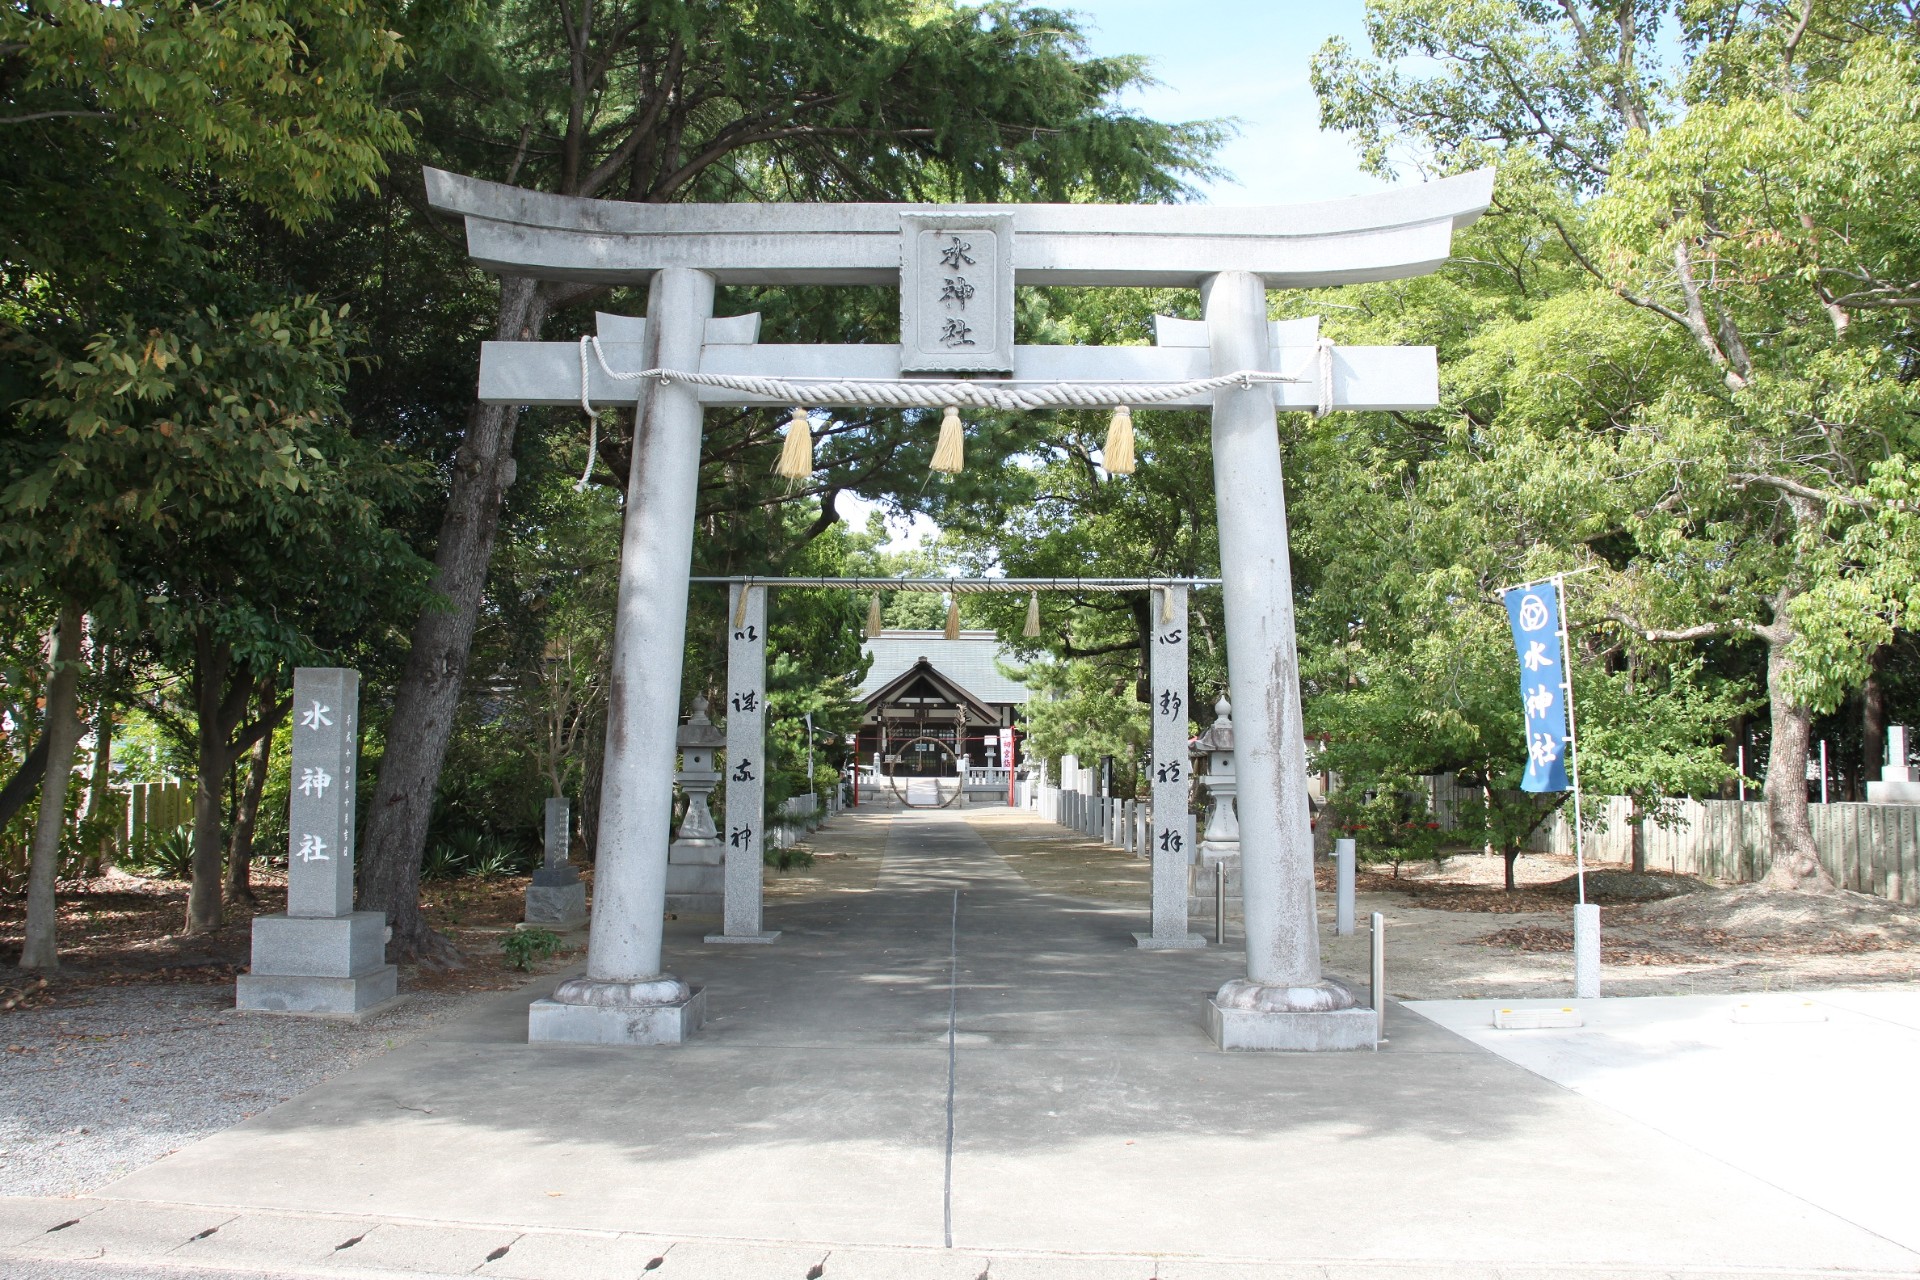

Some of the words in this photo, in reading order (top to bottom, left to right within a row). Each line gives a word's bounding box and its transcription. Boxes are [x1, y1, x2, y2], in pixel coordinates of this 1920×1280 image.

[938, 237, 976, 348] 水神社
[1524, 640, 1557, 768] 水神社
[296, 699, 334, 863] 水神社
